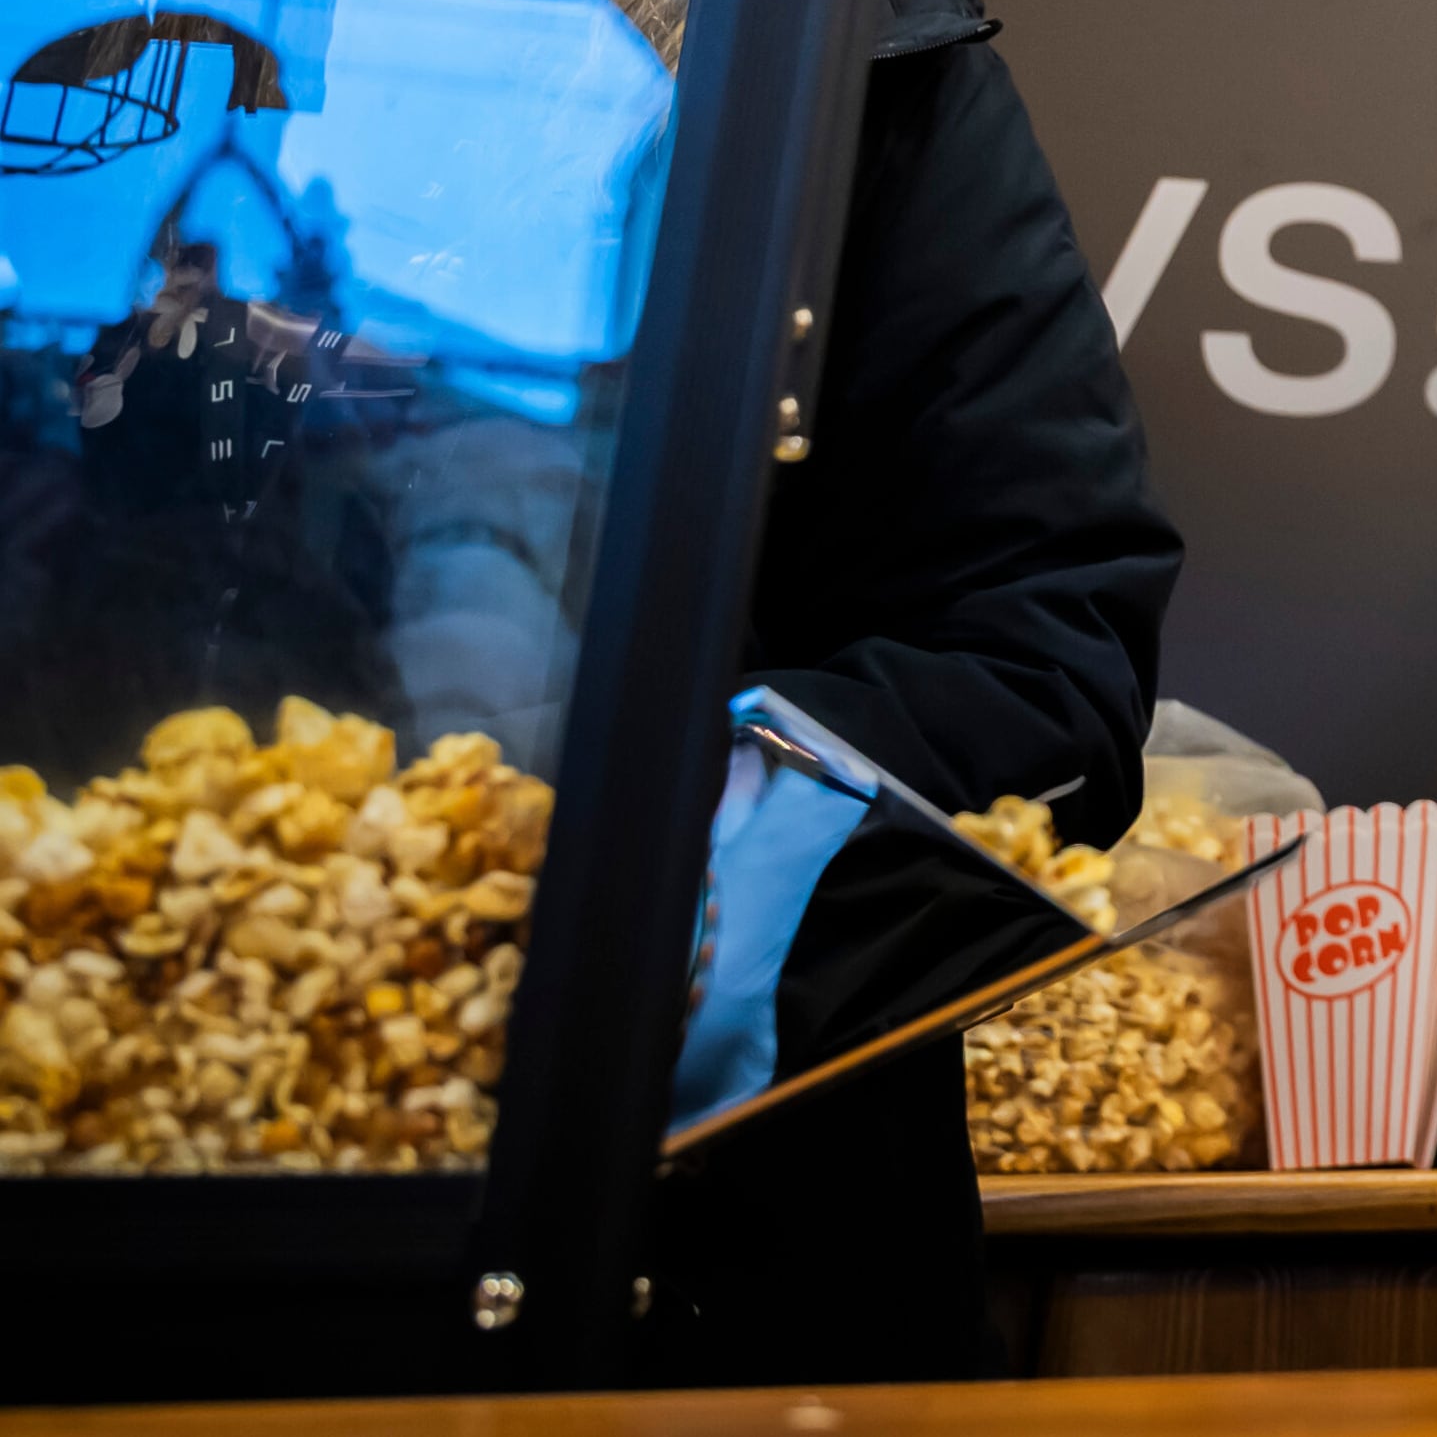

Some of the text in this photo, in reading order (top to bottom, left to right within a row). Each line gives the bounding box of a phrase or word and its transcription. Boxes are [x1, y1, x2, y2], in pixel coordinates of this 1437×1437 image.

[210, 326, 237, 524] TESL
[1292, 895, 1381, 948] POP
[1292, 922, 1406, 984] CORN
